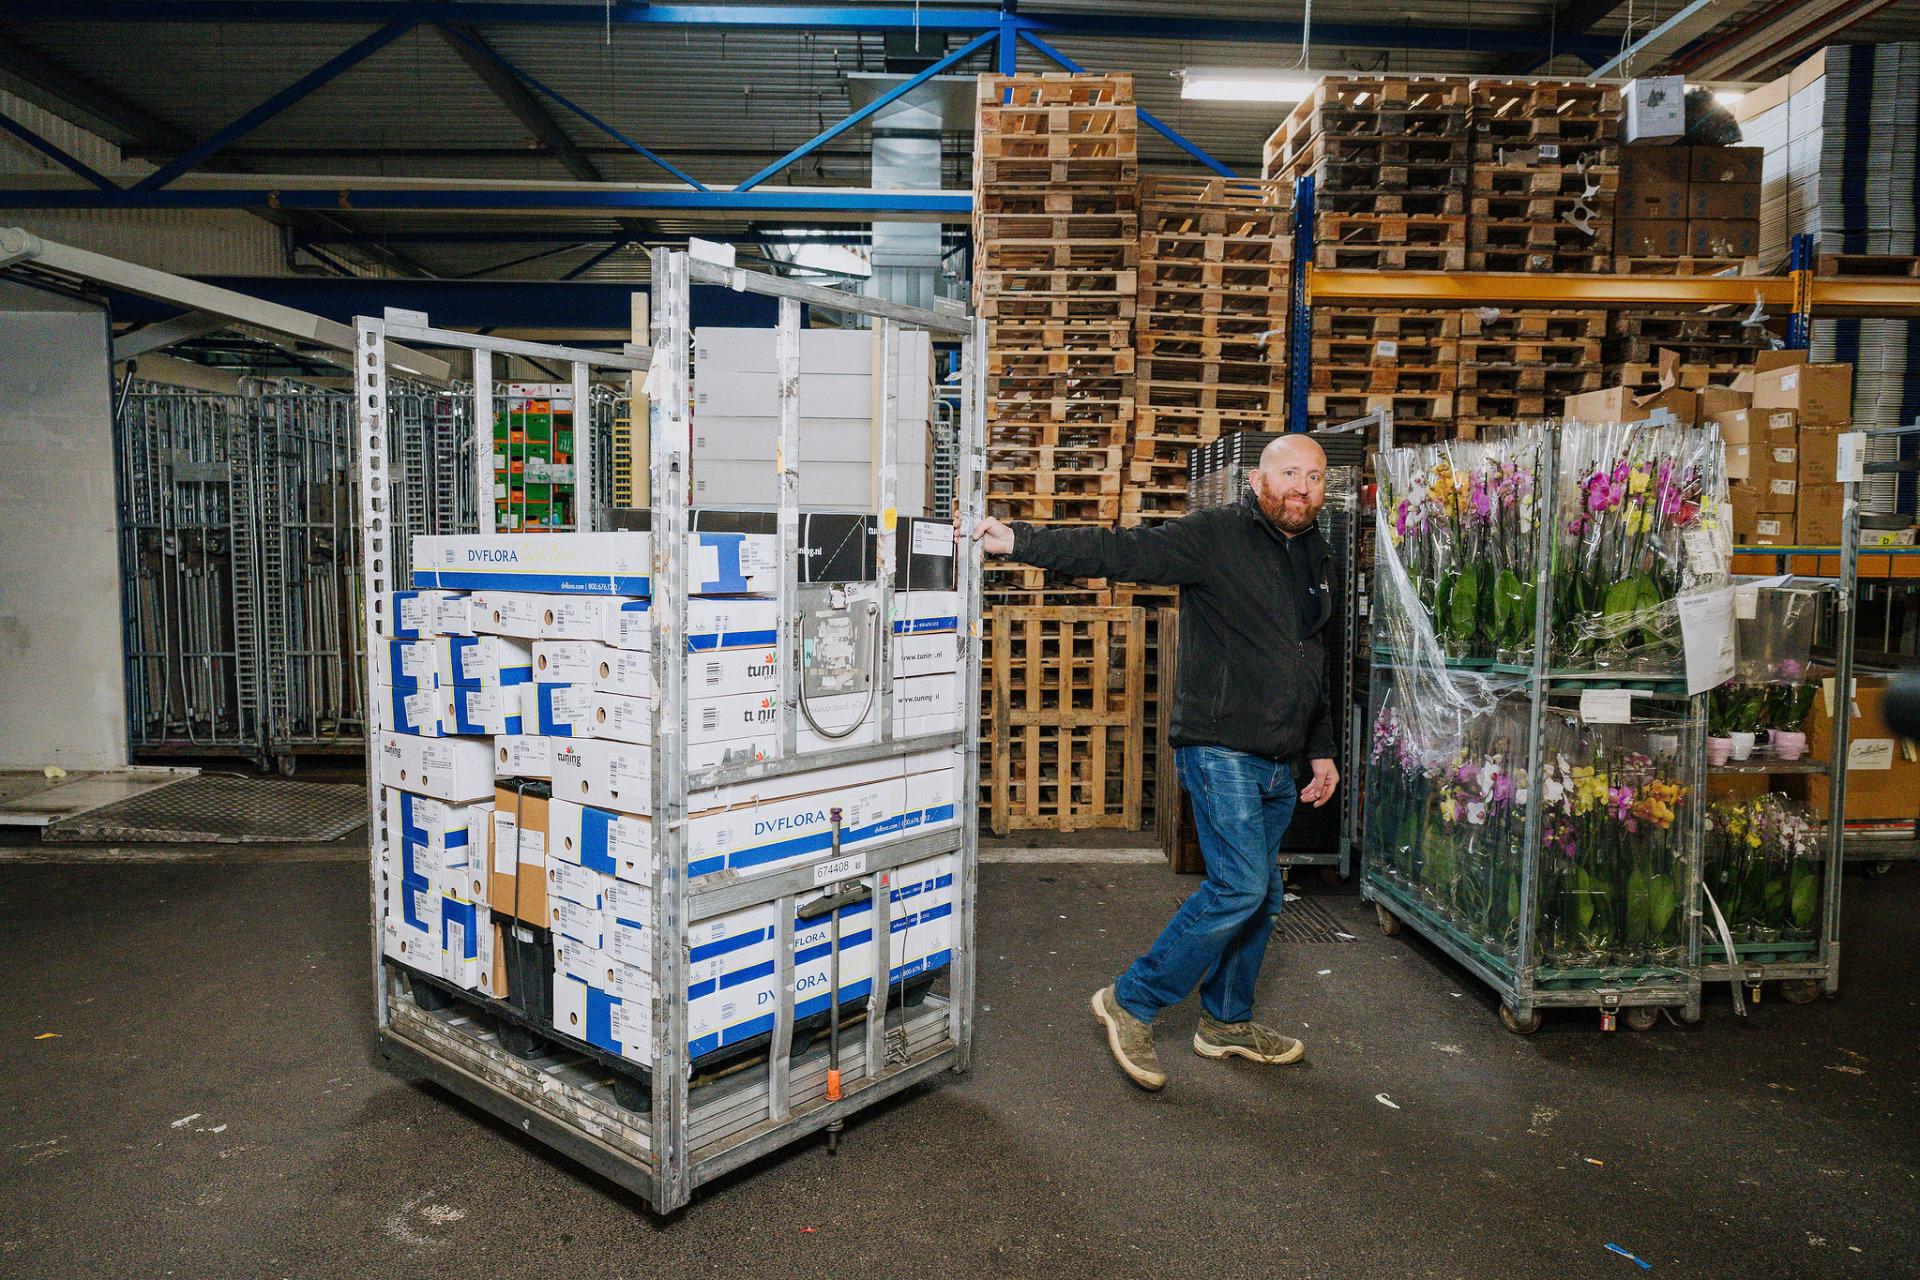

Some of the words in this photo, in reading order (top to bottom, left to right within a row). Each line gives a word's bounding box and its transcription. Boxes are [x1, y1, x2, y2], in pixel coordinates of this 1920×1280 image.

[468, 549, 518, 562] DVFLORA
[557, 753, 581, 767] tuning
[754, 810, 826, 835] DVFLORA
[817, 860, 849, 878] 674408
[794, 931, 826, 948] FLORA
